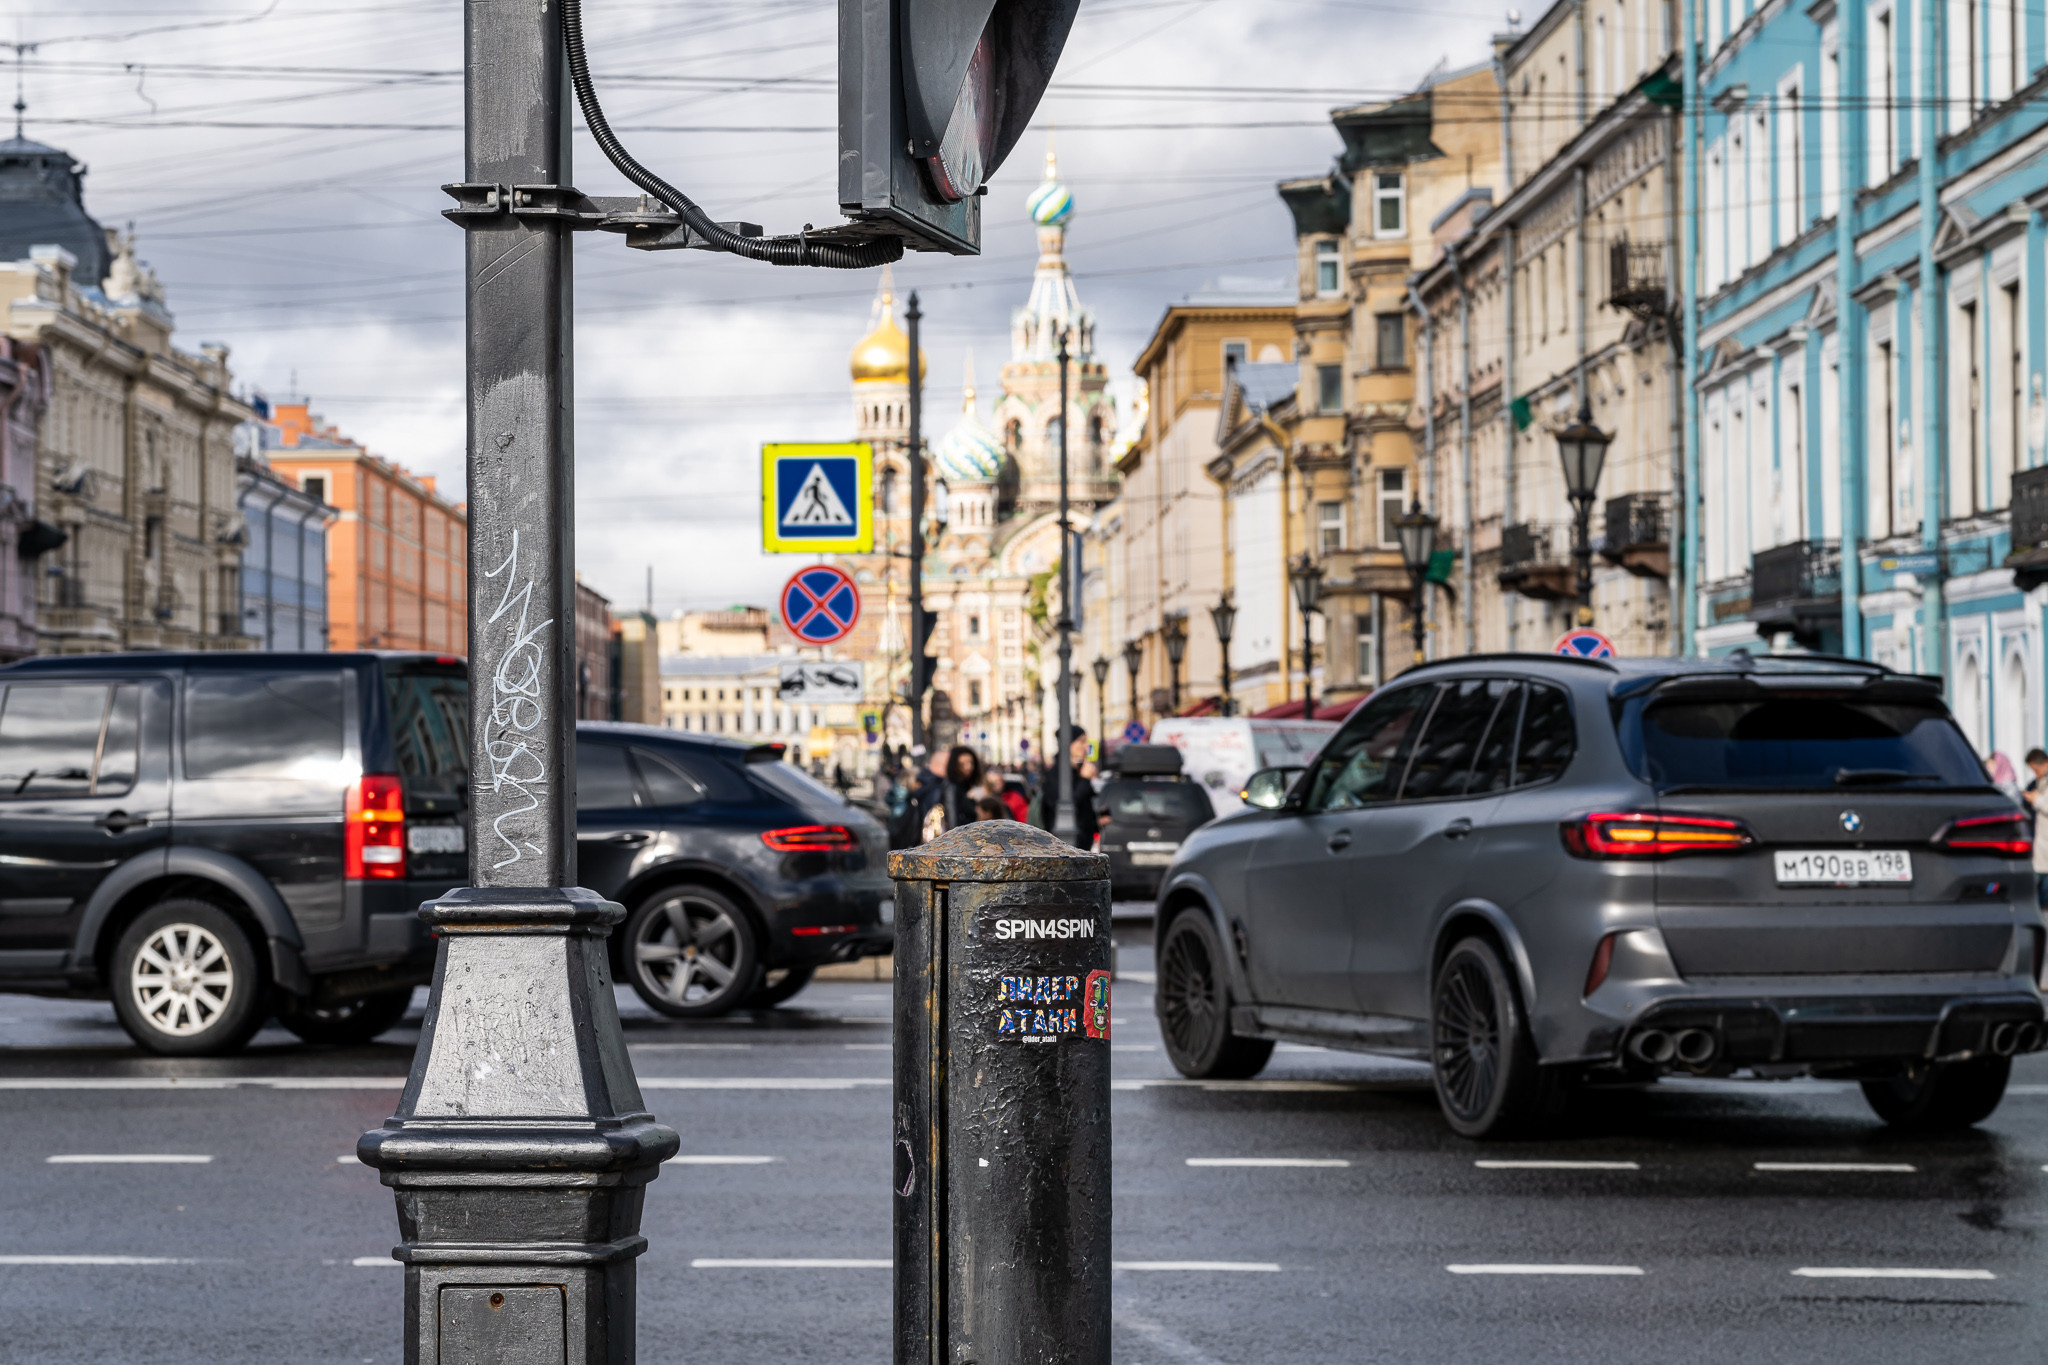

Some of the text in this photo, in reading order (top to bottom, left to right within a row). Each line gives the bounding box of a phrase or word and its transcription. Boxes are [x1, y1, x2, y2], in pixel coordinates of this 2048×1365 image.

[1874, 852, 1905, 872] 198
[995, 918, 1094, 940] SPIN4SPIN
[997, 975, 1079, 1005] ЛИДЕР
[997, 1008, 1077, 1035] АТАКИ
